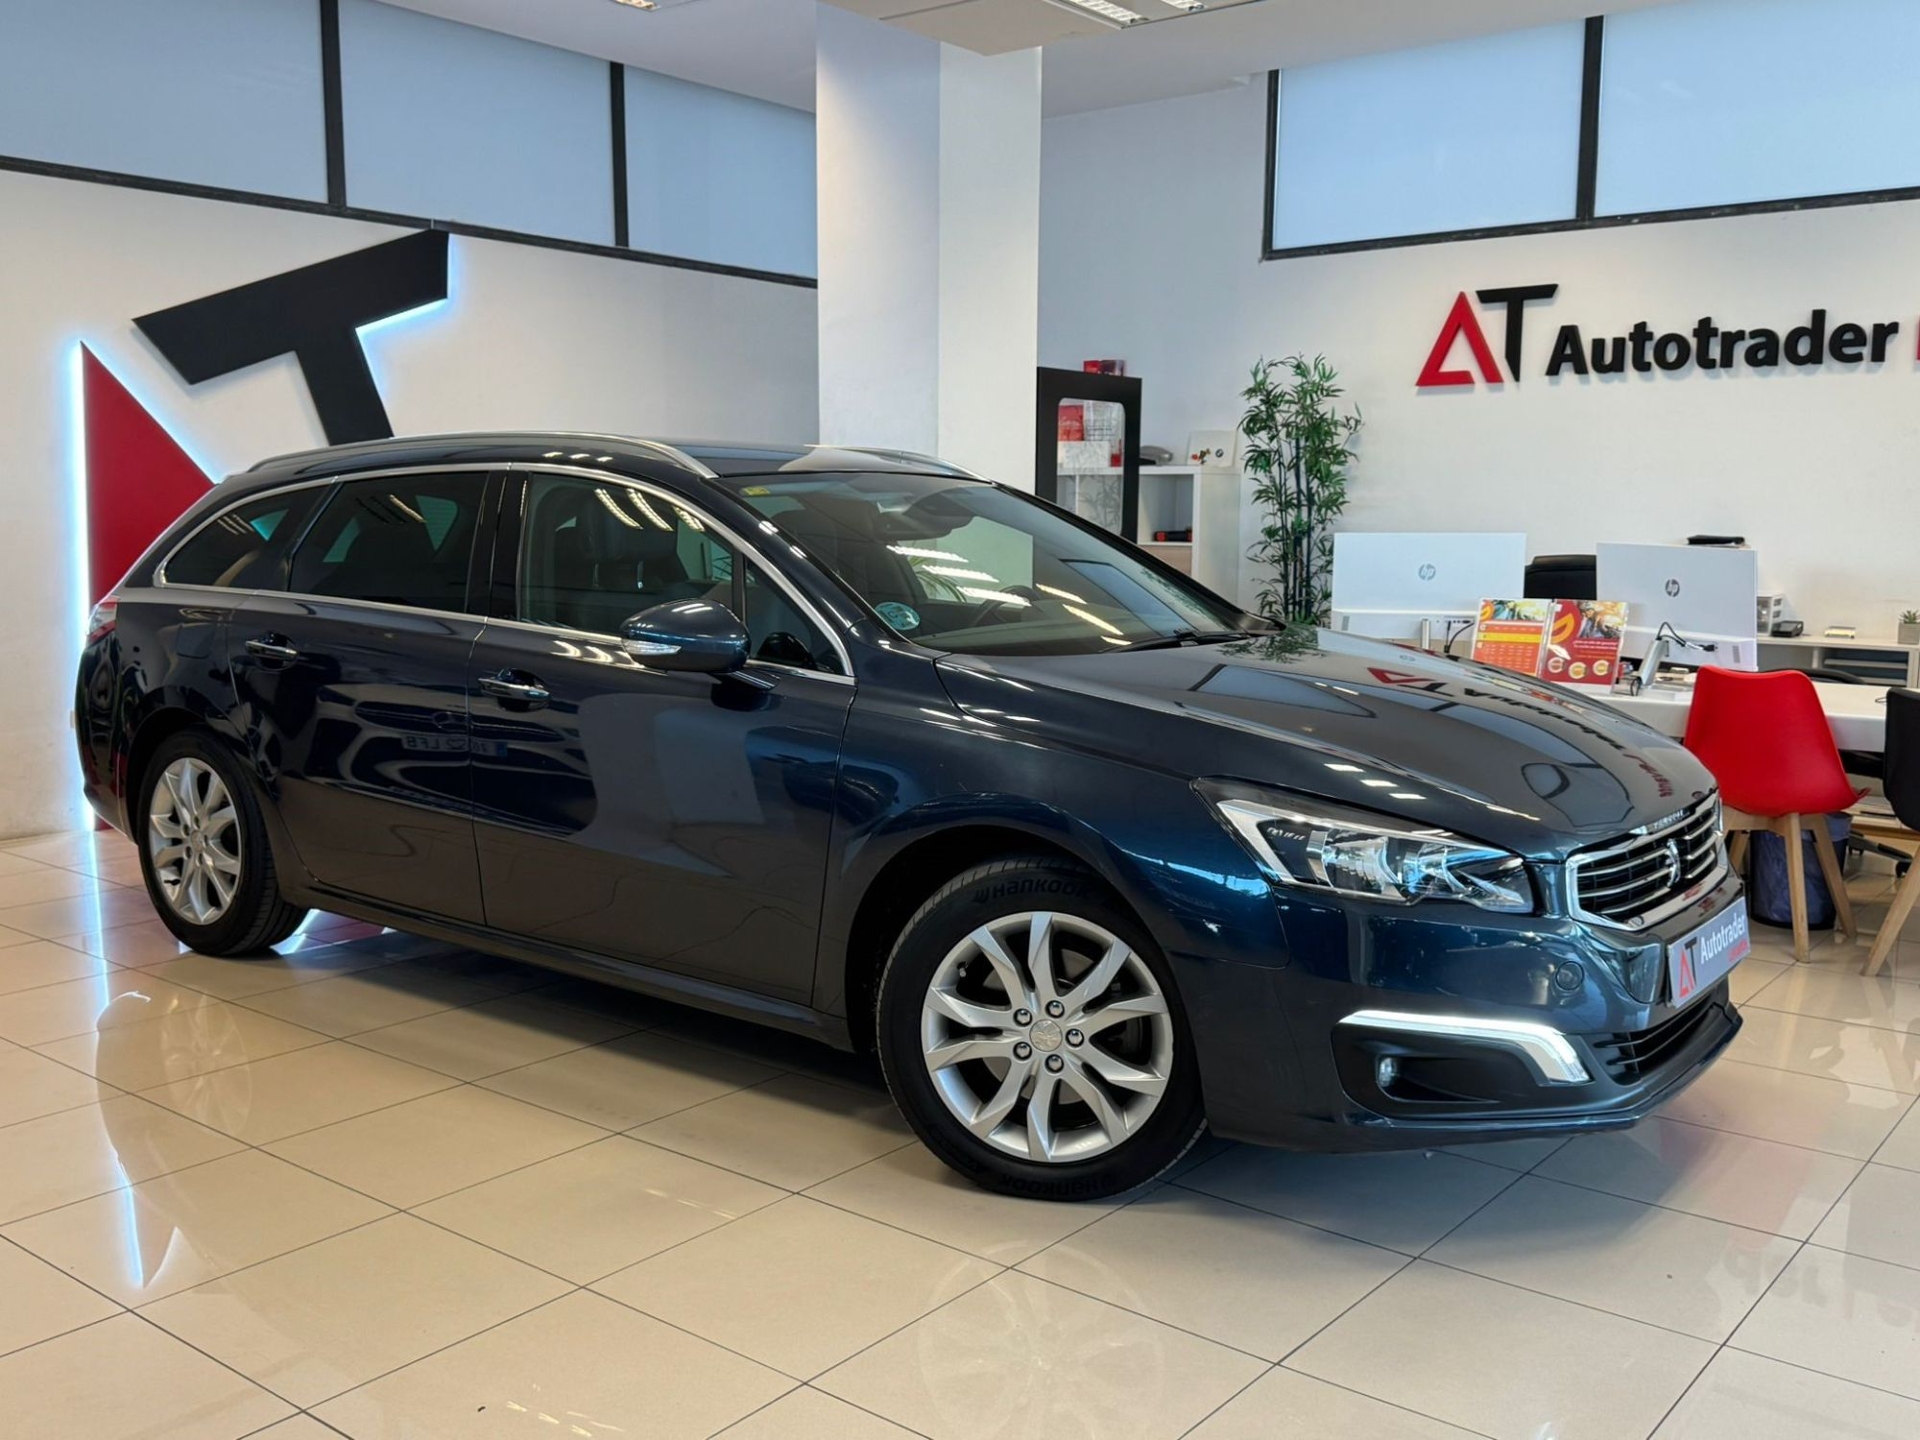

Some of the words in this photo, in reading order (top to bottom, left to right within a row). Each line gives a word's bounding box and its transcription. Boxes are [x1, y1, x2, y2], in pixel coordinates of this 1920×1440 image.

[1415, 284, 1558, 387] AT
[1545, 309, 1900, 377] Autotrader
[1679, 936, 1697, 998] AT
[1701, 912, 1746, 965] Autotrader
